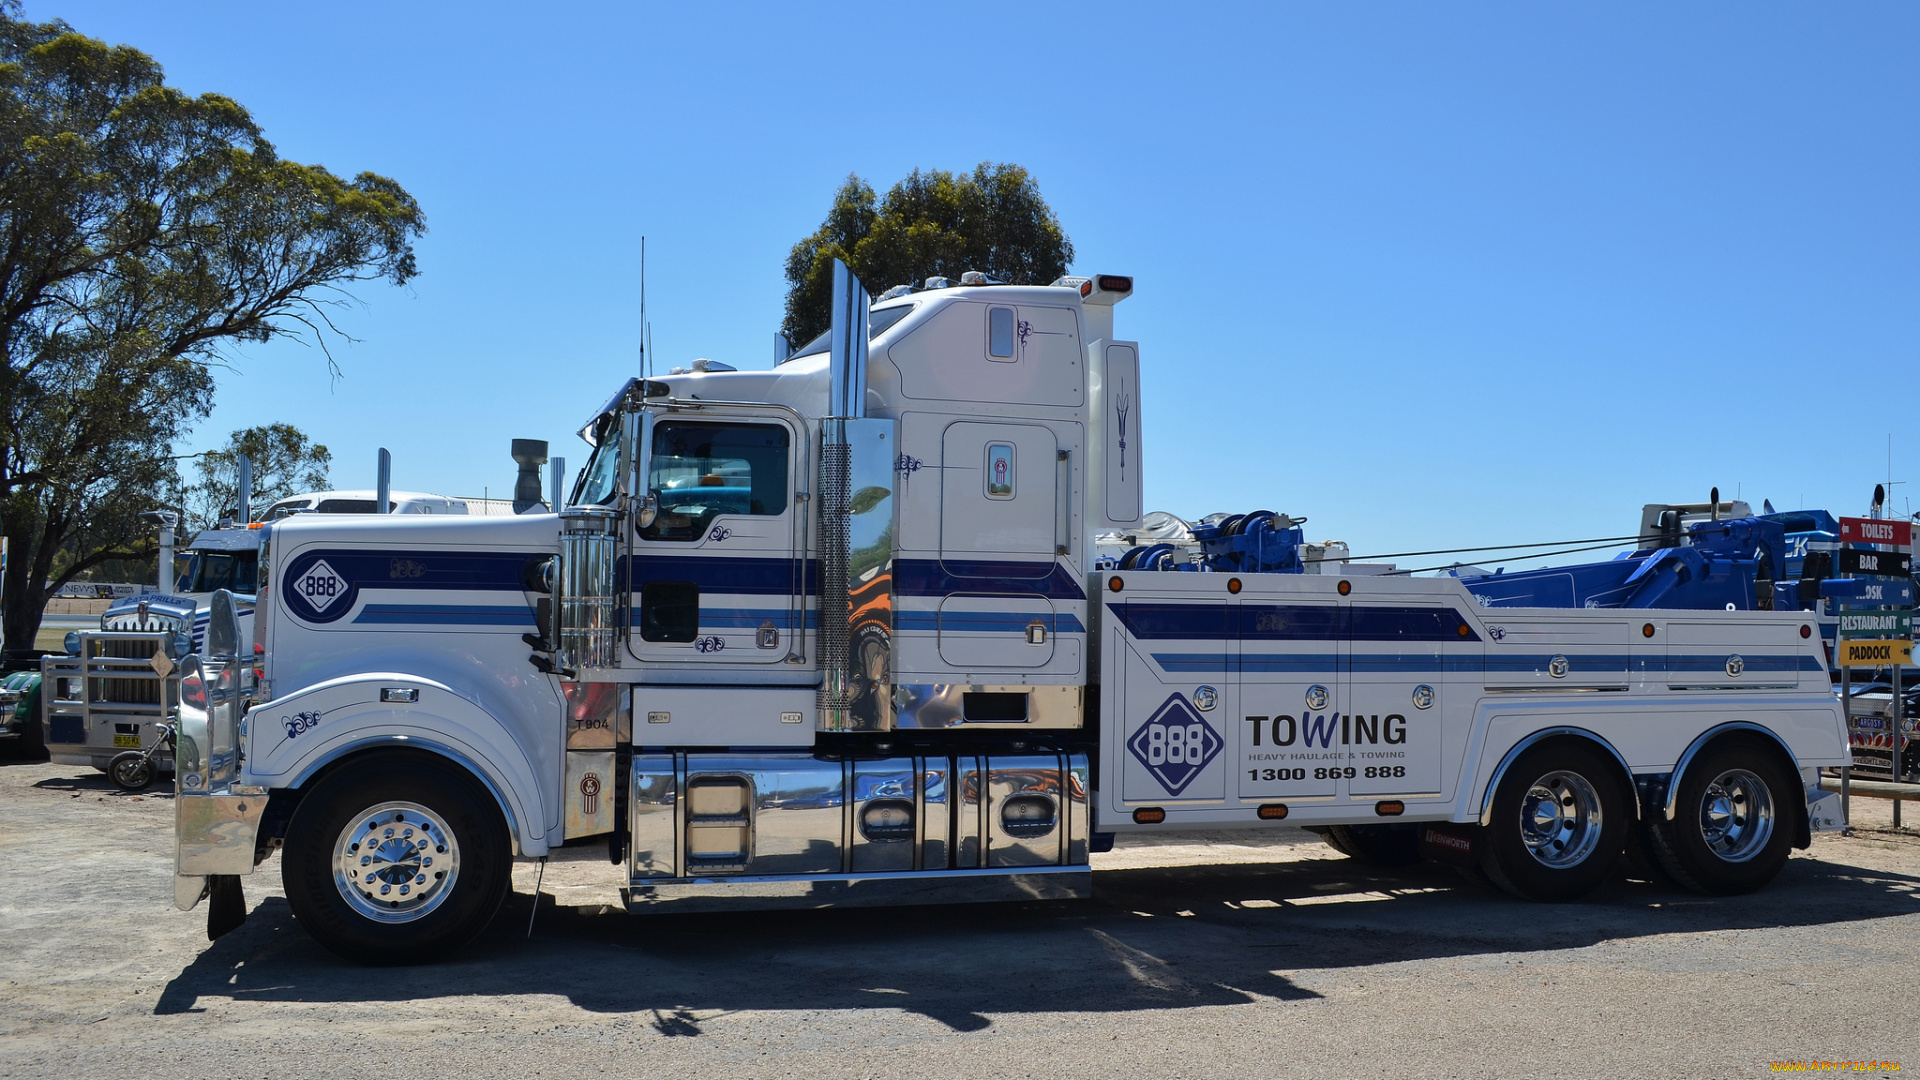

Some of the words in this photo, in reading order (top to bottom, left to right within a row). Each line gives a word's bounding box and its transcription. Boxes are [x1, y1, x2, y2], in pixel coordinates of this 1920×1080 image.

[1861, 523, 1894, 540] TOILETS
[1860, 555, 1878, 571] BAR
[65, 584, 95, 594] NEWS
[306, 575, 336, 597] 888
[1856, 585, 1883, 600] OSK
[1841, 615, 1898, 631] RESTAURANT
[1849, 645, 1891, 660] PADDOCK
[1245, 711, 1407, 749] TOWING
[1148, 723, 1204, 766] 888
[1248, 753, 1287, 761] HEAVY
[1290, 752, 1345, 761] HAULAGE
[1348, 752, 1356, 760] &
[1360, 751, 1406, 760] TOWING
[1248, 768, 1306, 781] 1300
[1313, 767, 1357, 780] 869
[1364, 766, 1406, 779] 888
[1432, 834, 1470, 850] KENWORTH
